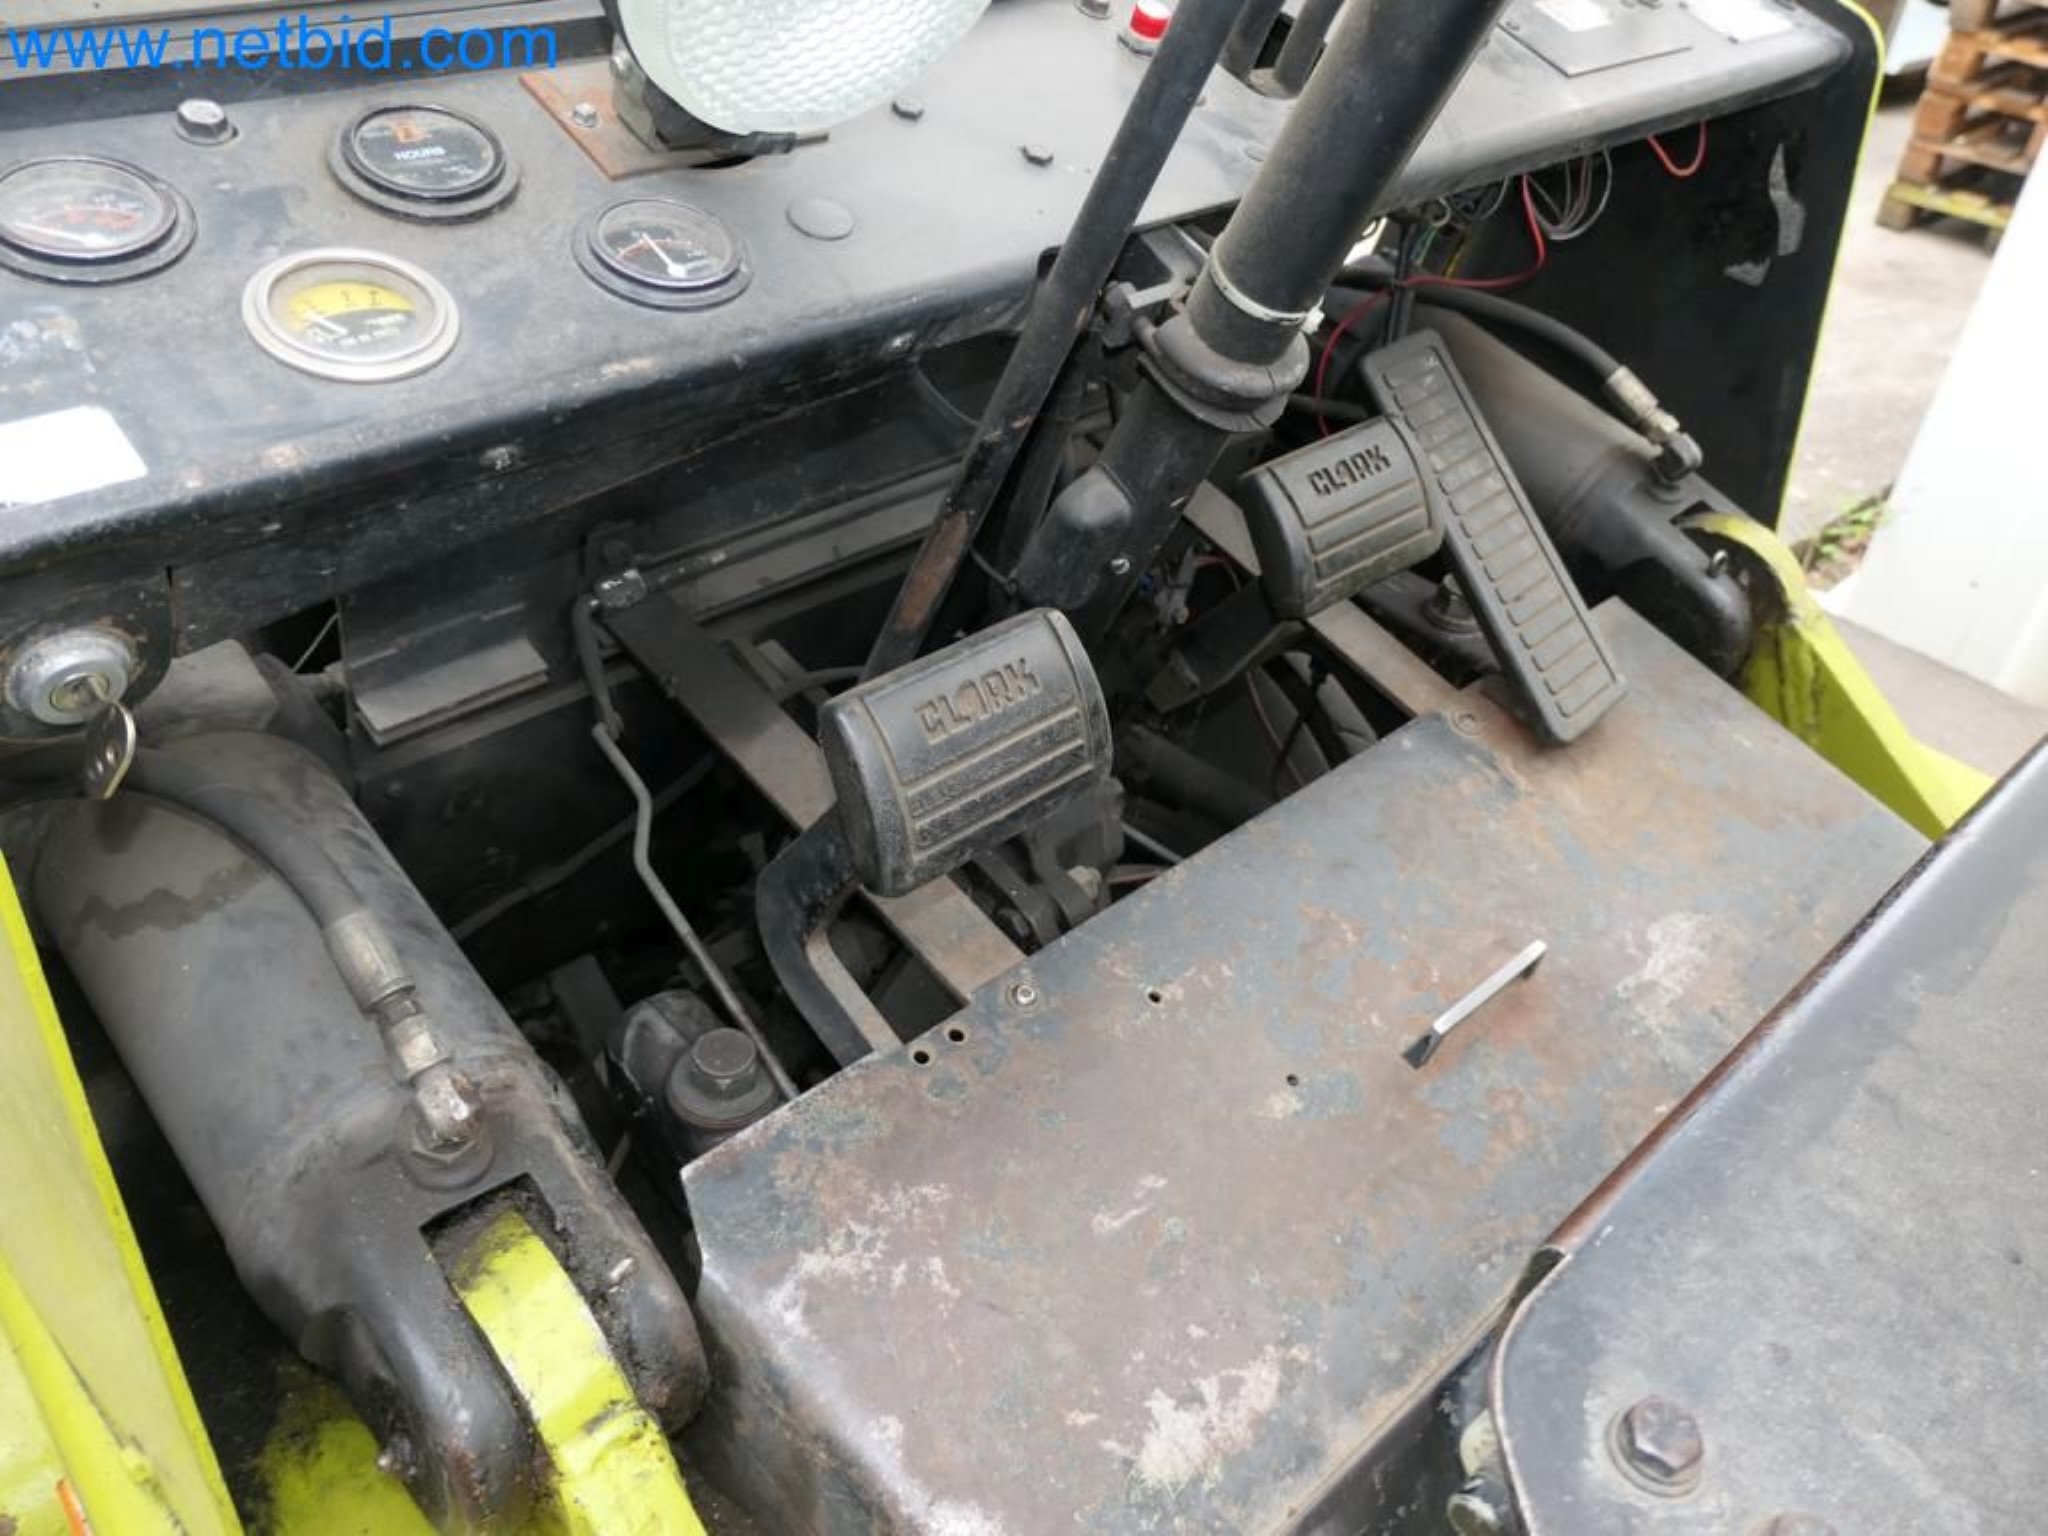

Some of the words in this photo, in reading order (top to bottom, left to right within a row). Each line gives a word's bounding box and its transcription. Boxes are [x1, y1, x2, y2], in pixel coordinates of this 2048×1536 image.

[393, 146, 446, 161] HOURS
[1307, 444, 1391, 496] CLARK
[914, 657, 1040, 744] CLARK
